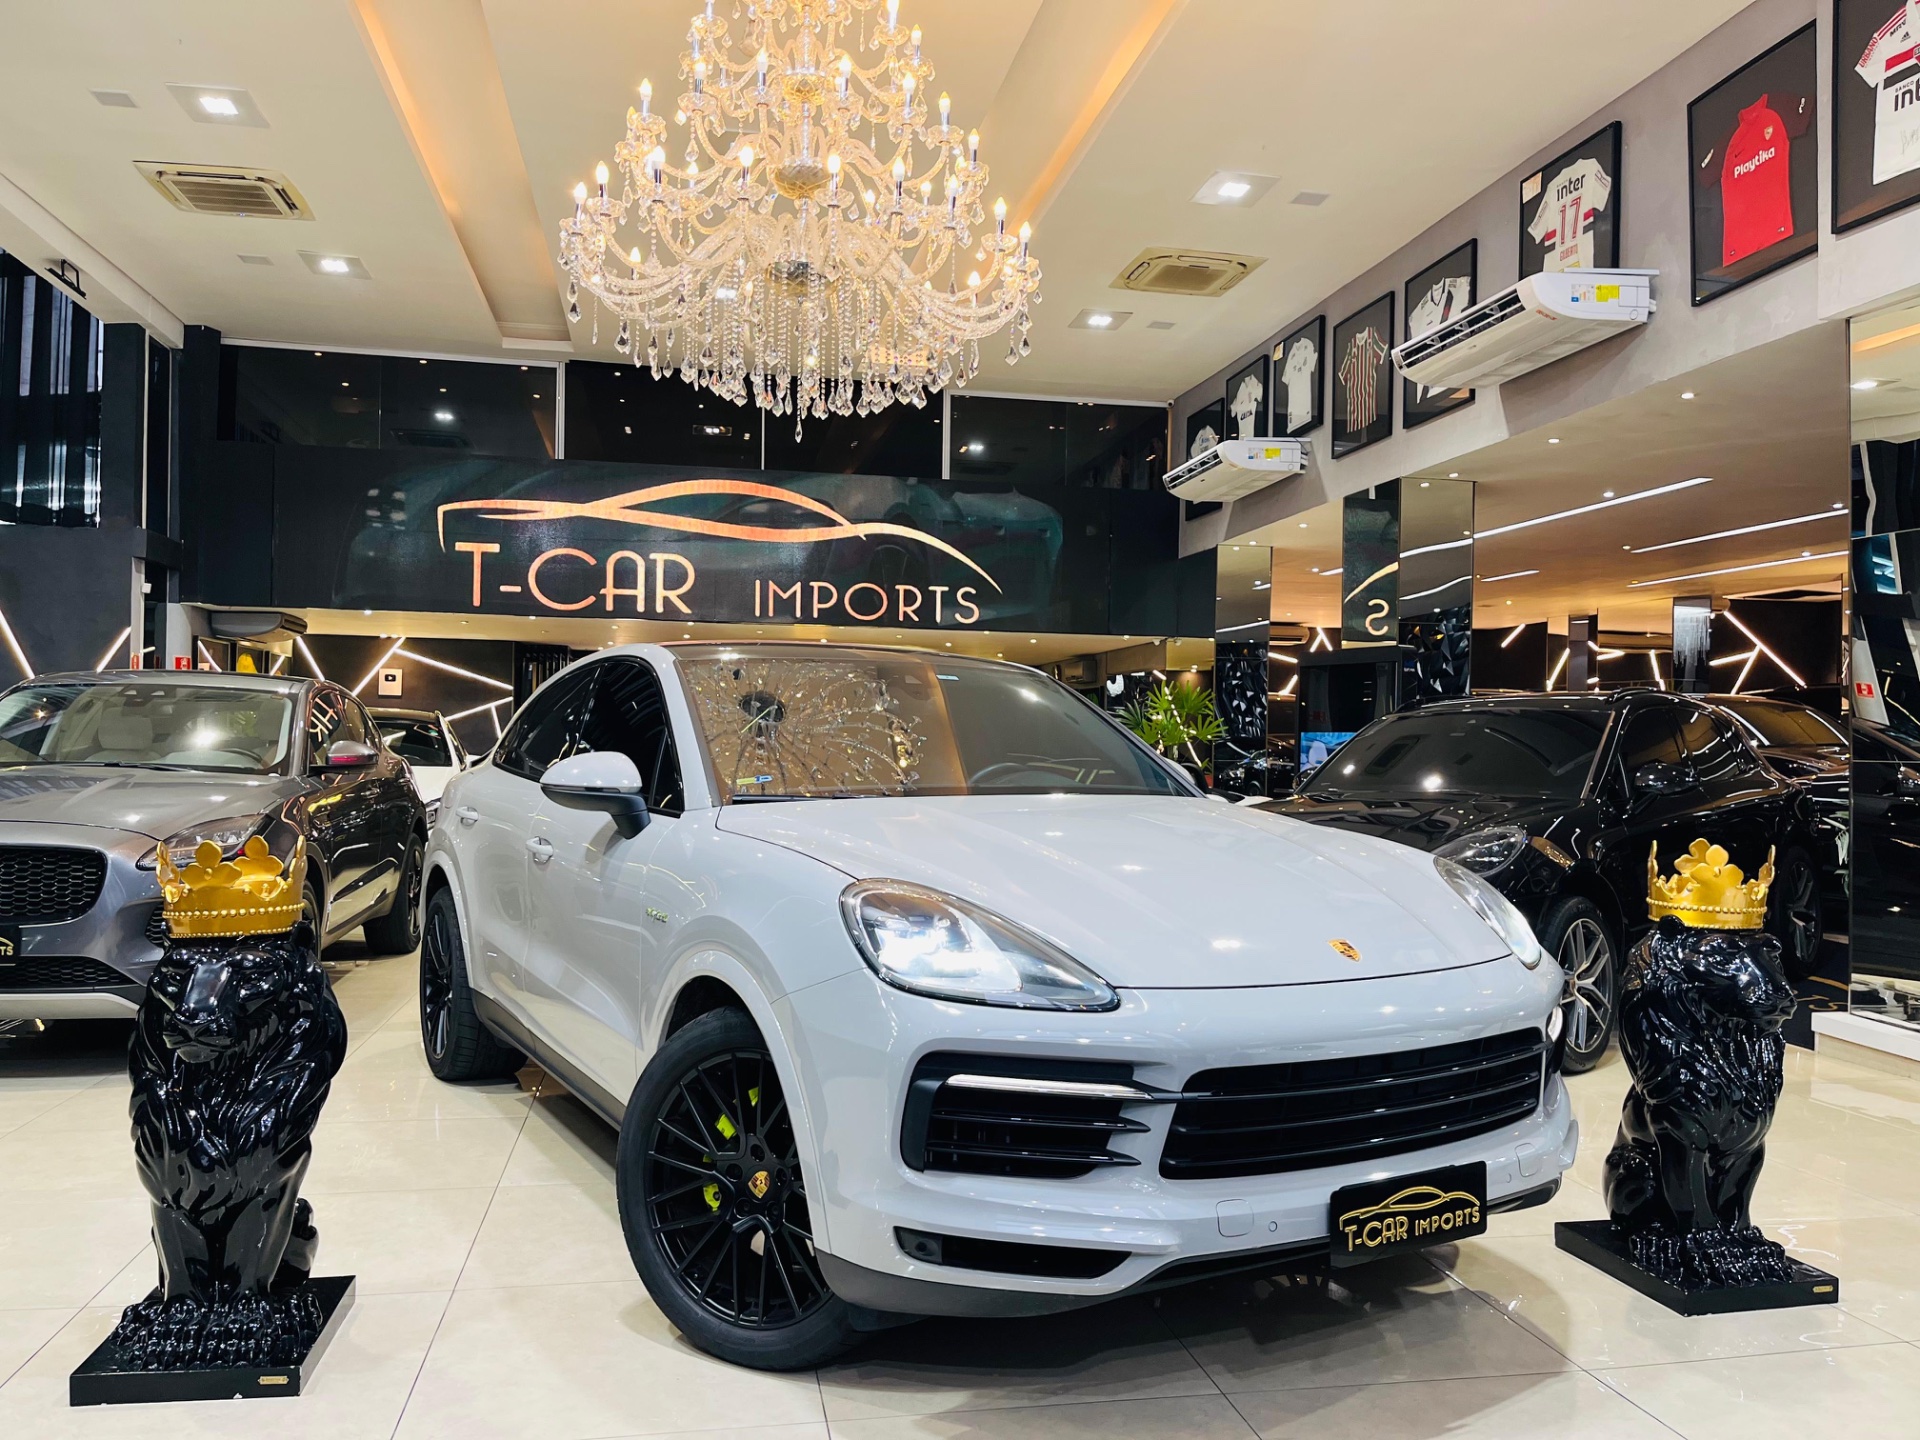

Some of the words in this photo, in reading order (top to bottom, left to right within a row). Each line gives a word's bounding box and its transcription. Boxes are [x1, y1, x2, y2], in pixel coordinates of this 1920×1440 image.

[1858, 36, 1879, 68] URBANO
[1895, 80, 1915, 93] BANCO
[1734, 147, 1776, 179] Playtika
[1557, 174, 1586, 202] inter
[1560, 195, 1582, 245] 17
[454, 541, 696, 614] T-CAR
[754, 578, 981, 625] IMPORTS
[1344, 1215, 1409, 1252] T-CAR
[1415, 1206, 1481, 1237] IMPORTS
